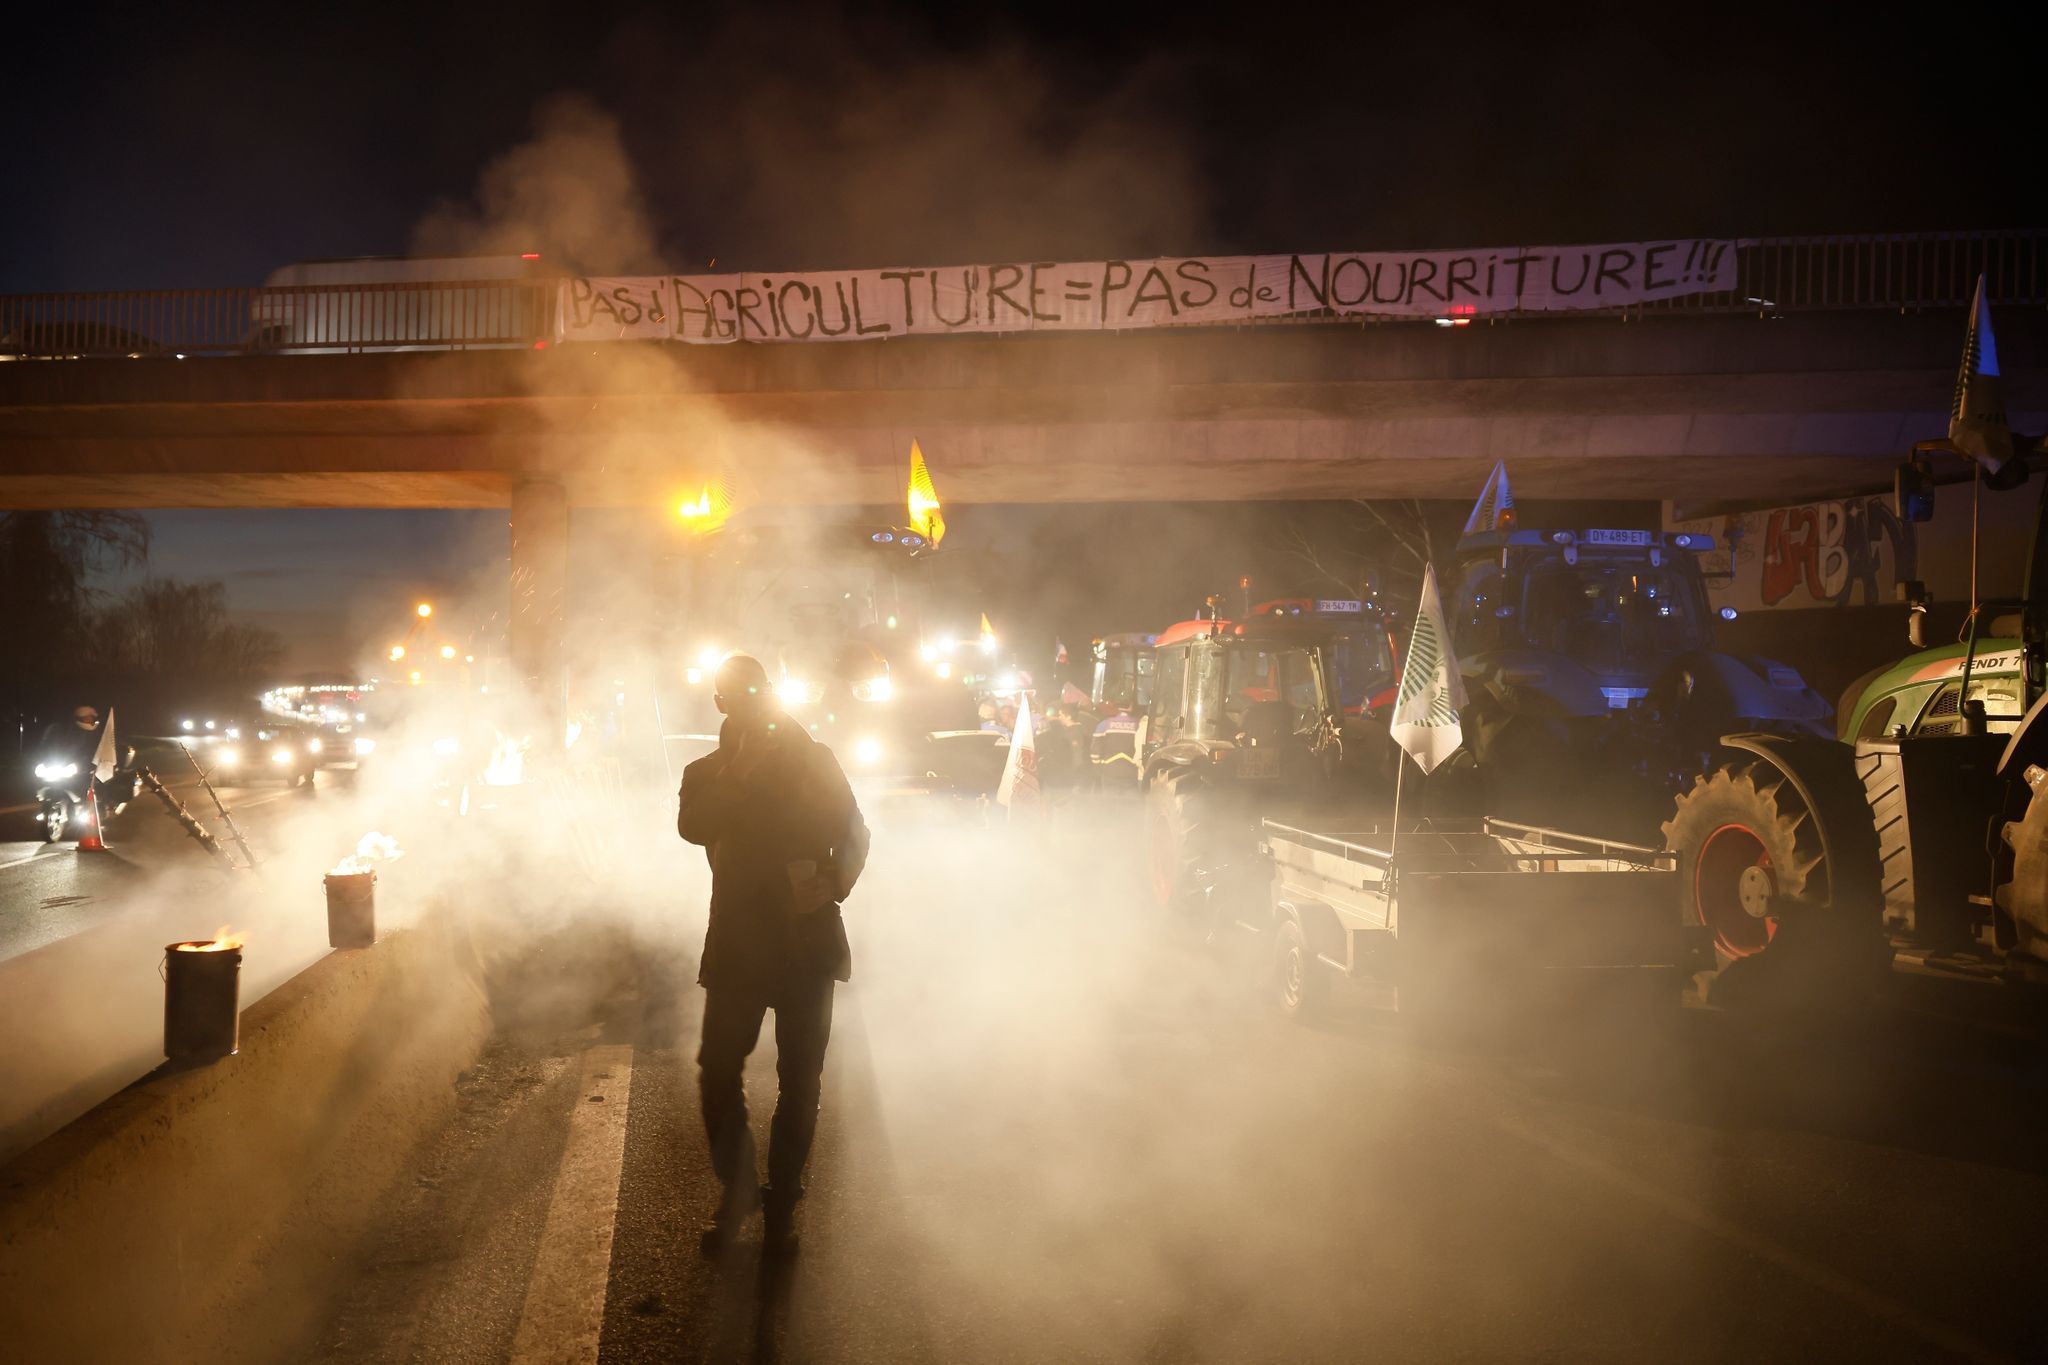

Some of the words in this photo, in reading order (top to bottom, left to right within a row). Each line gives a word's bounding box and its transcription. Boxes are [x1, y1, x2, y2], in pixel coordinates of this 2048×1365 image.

[571, 276, 643, 328] PAS
[1101, 260, 1218, 322] PAS
[1228, 263, 1282, 309] de
[1958, 657, 2008, 671] FENDT
